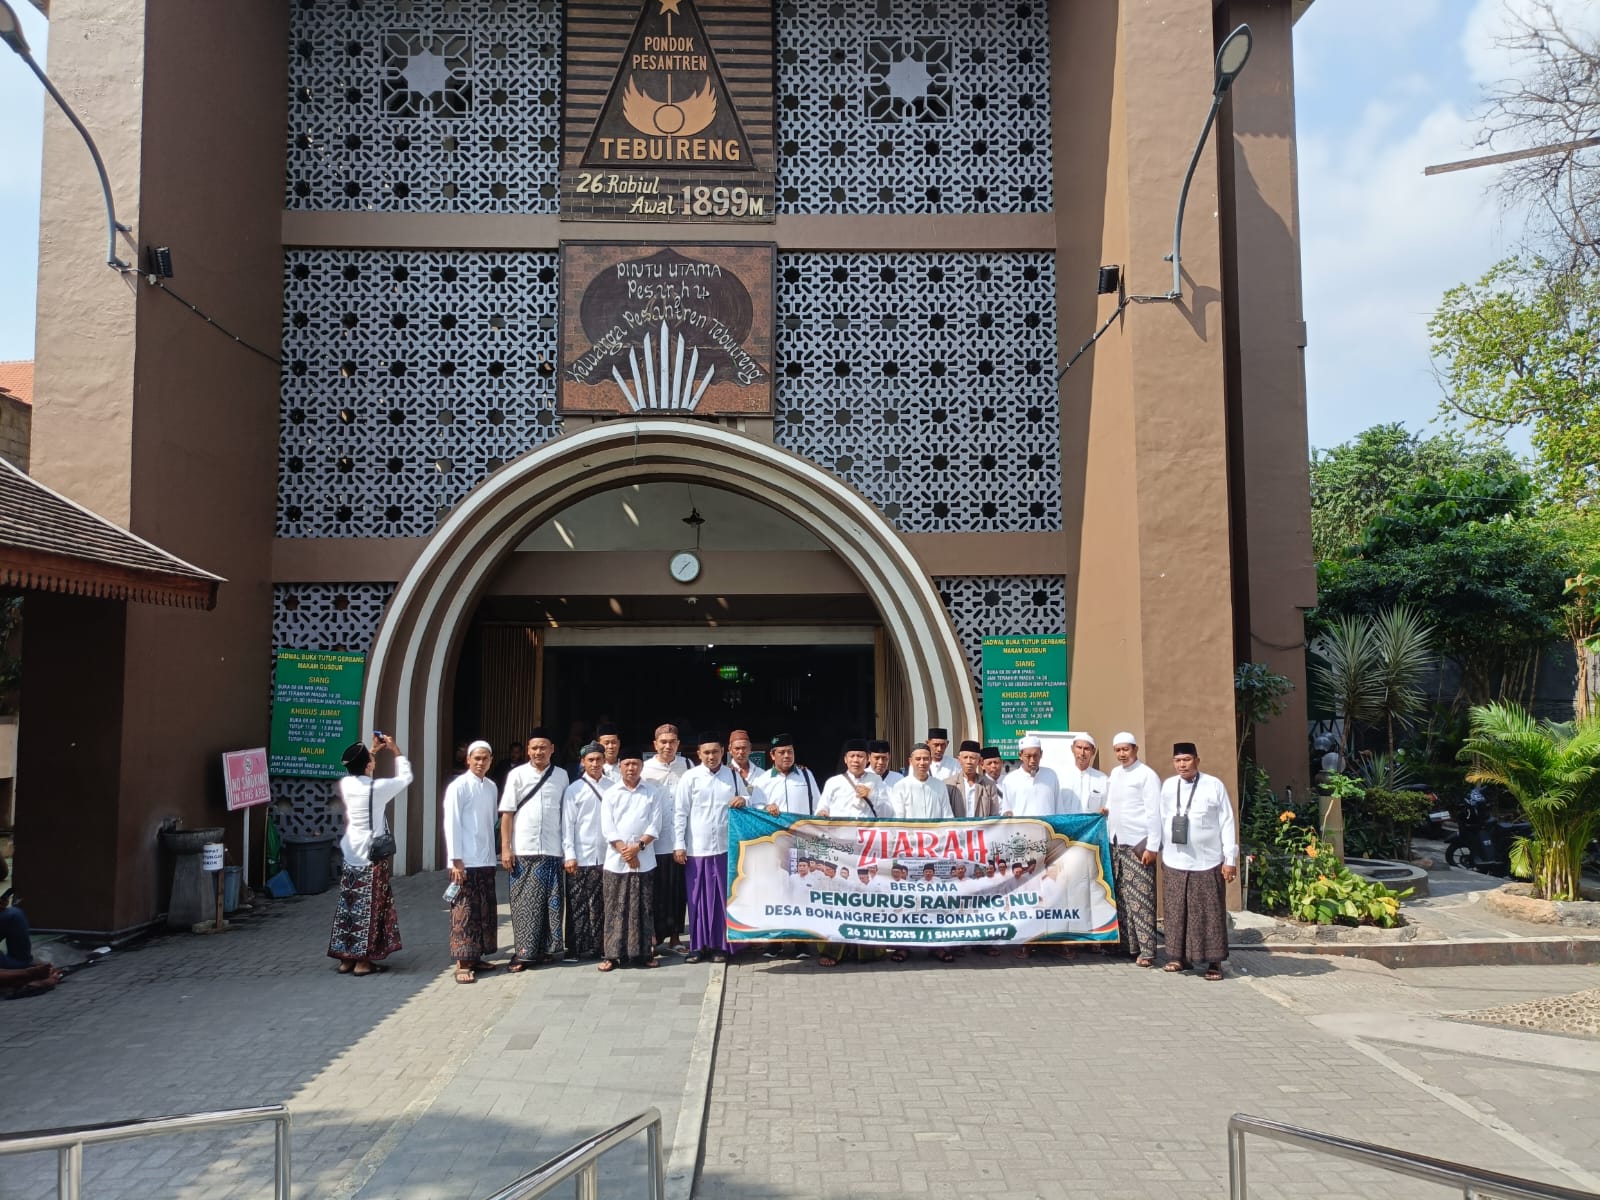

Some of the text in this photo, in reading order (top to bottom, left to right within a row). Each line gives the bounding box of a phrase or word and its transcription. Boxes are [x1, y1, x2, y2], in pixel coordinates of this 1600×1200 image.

[644, 36, 694, 52] PONDOK
[632, 55, 708, 71] PESANTREN
[600, 138, 741, 161] TEBUIRENG
[576, 172, 660, 194] 26 Robiul
[628, 196, 676, 215] Awal
[616, 262, 722, 280] PINTU UTAMA
[278, 652, 300, 660] JADWAL
[300, 747, 324, 755] MALAM
[232, 777, 240, 792] NO
[233, 785, 269, 805] IN THIS AREA
[858, 828, 988, 868] ZIARAH
[890, 882, 958, 892] BERSAMA
[810, 891, 1038, 909] PENGURUS RANTING NU
[765, 905, 1080, 924] DESA BONANGREJO KEC. BONANG KAB. DEMAK
[847, 927, 860, 937] 26
[864, 928, 886, 939] JULI
[889, 930, 916, 939] 2025
[928, 930, 932, 939] 1
[935, 929, 980, 939] SHAFAR
[984, 927, 1008, 937] 1447
